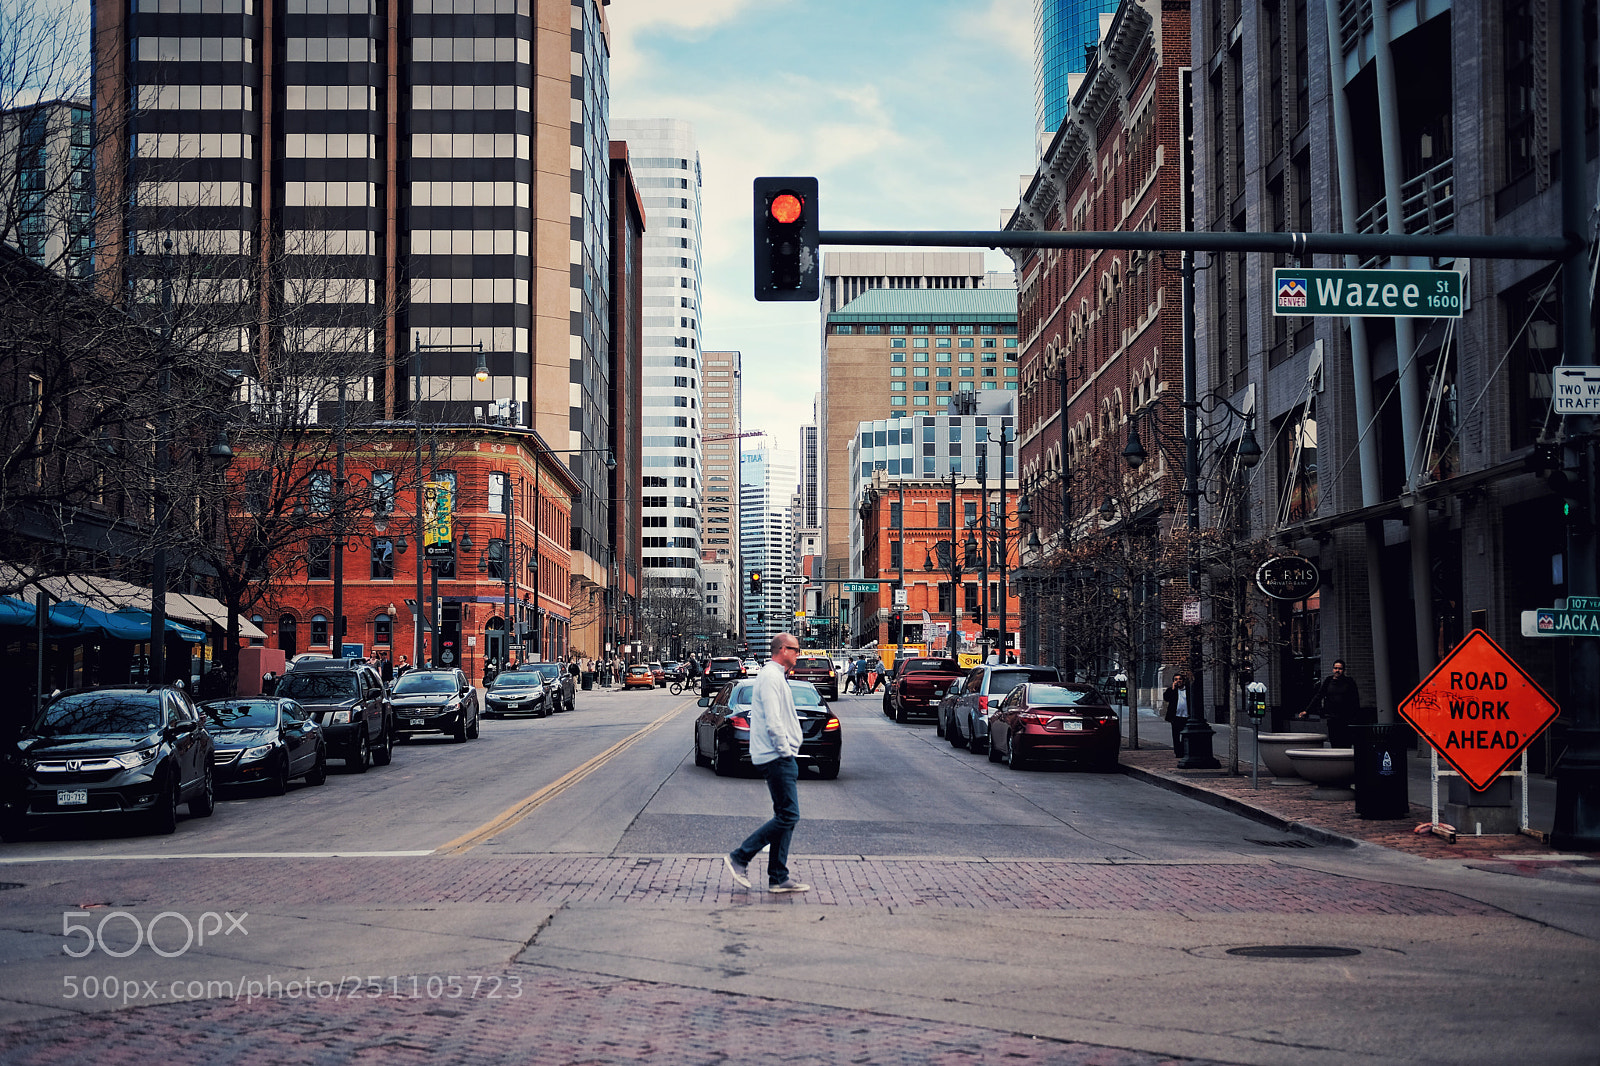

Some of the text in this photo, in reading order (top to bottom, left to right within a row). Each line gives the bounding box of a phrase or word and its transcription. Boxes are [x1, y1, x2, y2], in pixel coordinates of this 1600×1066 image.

[1315, 278, 1449, 307] Wazee St
[1427, 295, 1459, 308] 1600
[1559, 384, 1582, 395] TWO
[747, 454, 763, 463] TIAA
[1572, 599, 1588, 608] 107
[1555, 614, 1588, 631] JACK
[1450, 672, 1508, 690] ROAD
[1449, 701, 1510, 719] WORK
[1445, 730, 1519, 749] AHEAD
